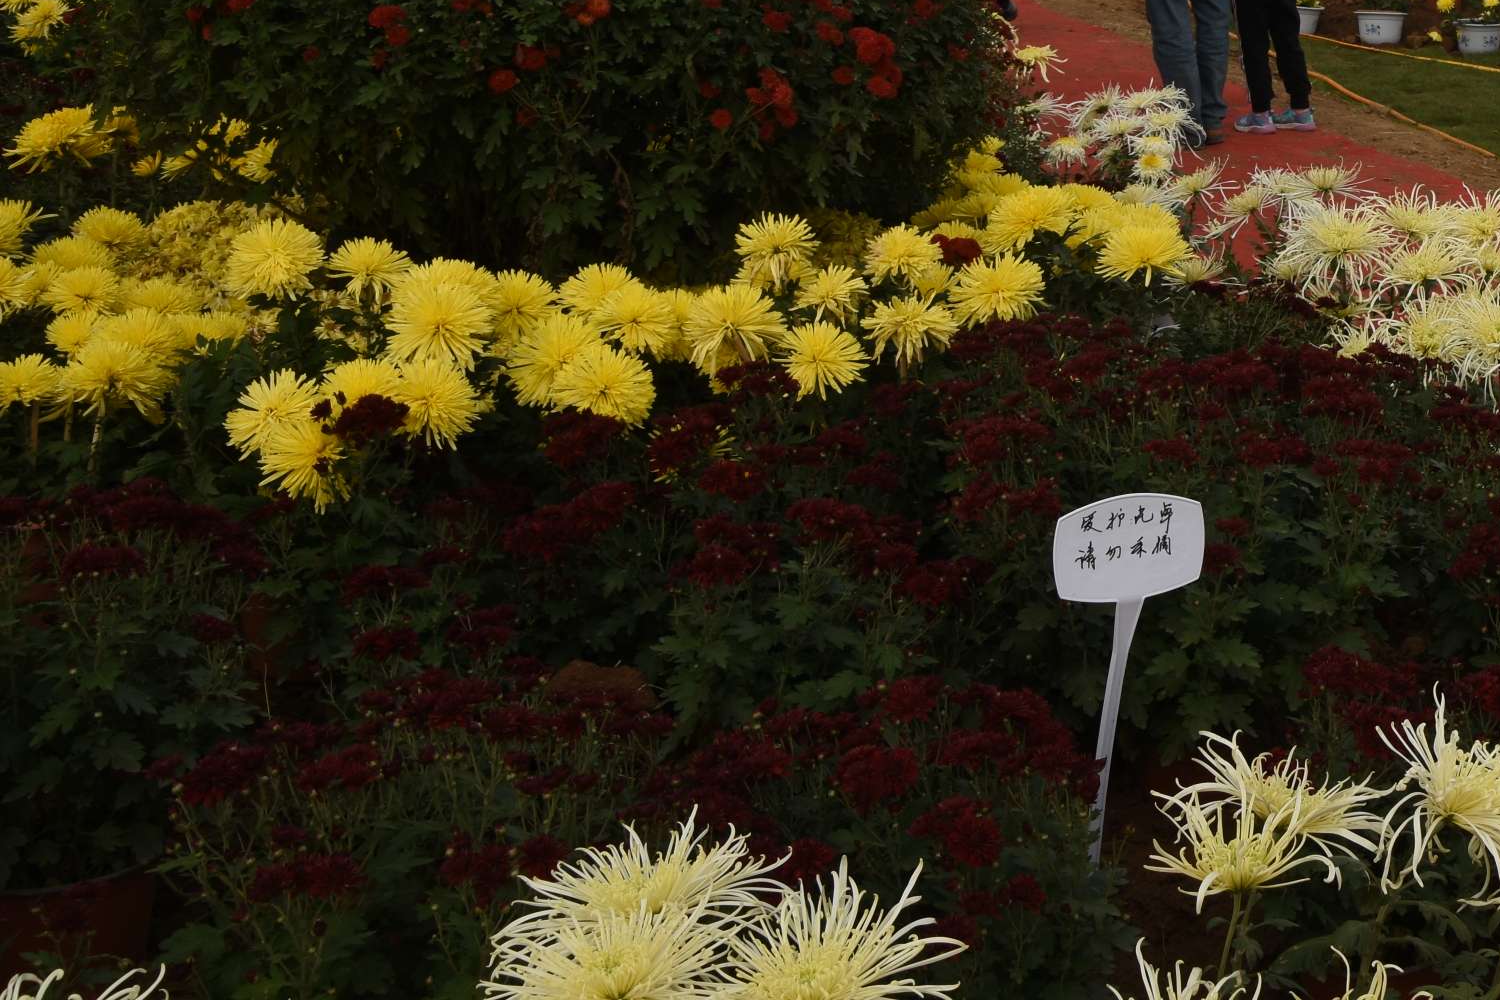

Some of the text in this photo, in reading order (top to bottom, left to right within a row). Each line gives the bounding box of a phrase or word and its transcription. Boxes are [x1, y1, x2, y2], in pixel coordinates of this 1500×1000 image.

[1079, 501, 1175, 535] 爱护花草
[1074, 534, 1173, 571] 请勿采摘
